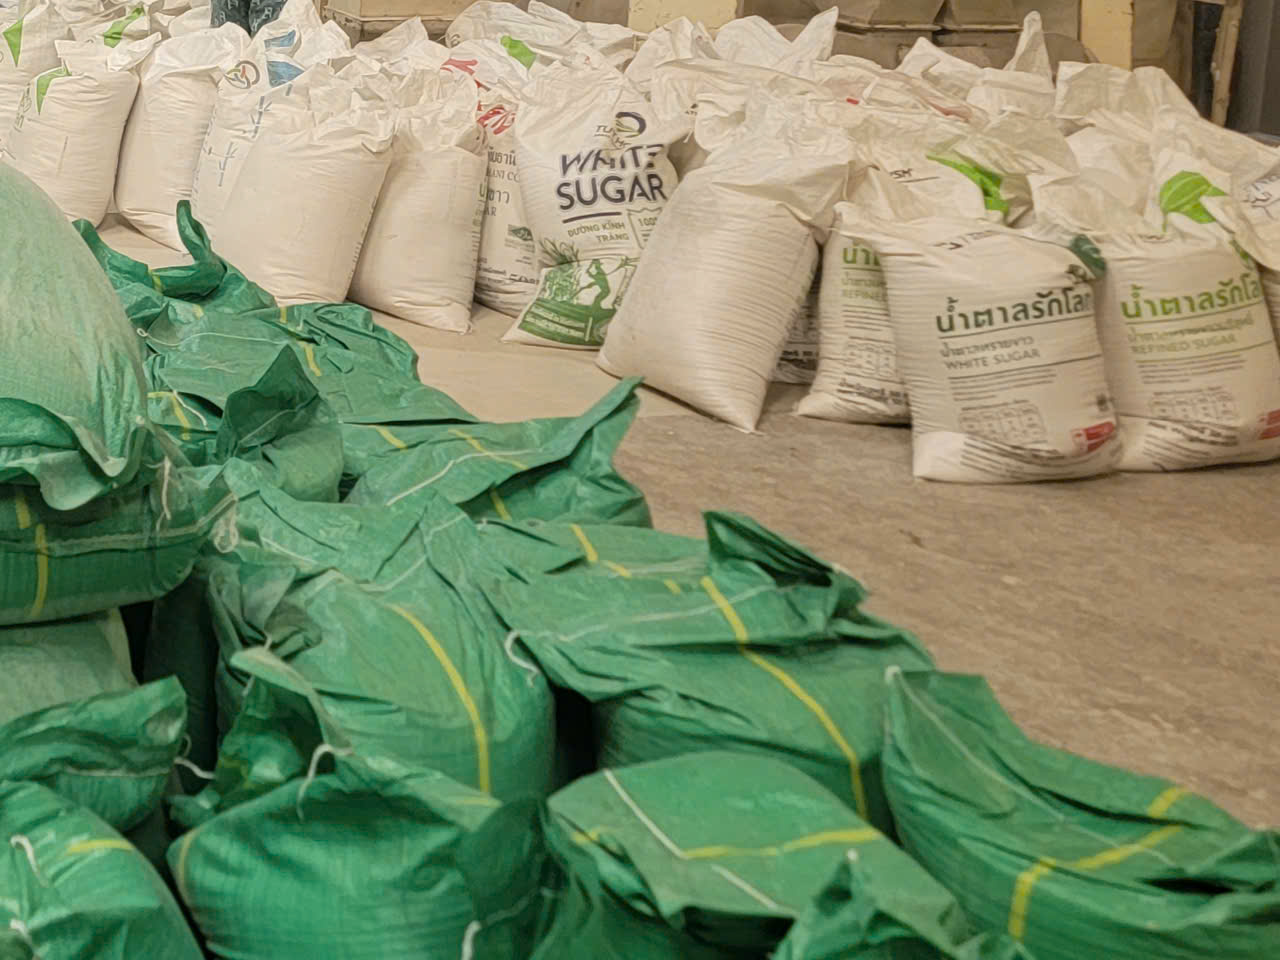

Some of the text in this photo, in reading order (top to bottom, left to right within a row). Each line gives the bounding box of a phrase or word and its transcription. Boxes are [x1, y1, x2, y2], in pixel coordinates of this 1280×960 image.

[556, 173, 669, 211] SUGAR
[945, 348, 1041, 371] WHITE SUGAR
